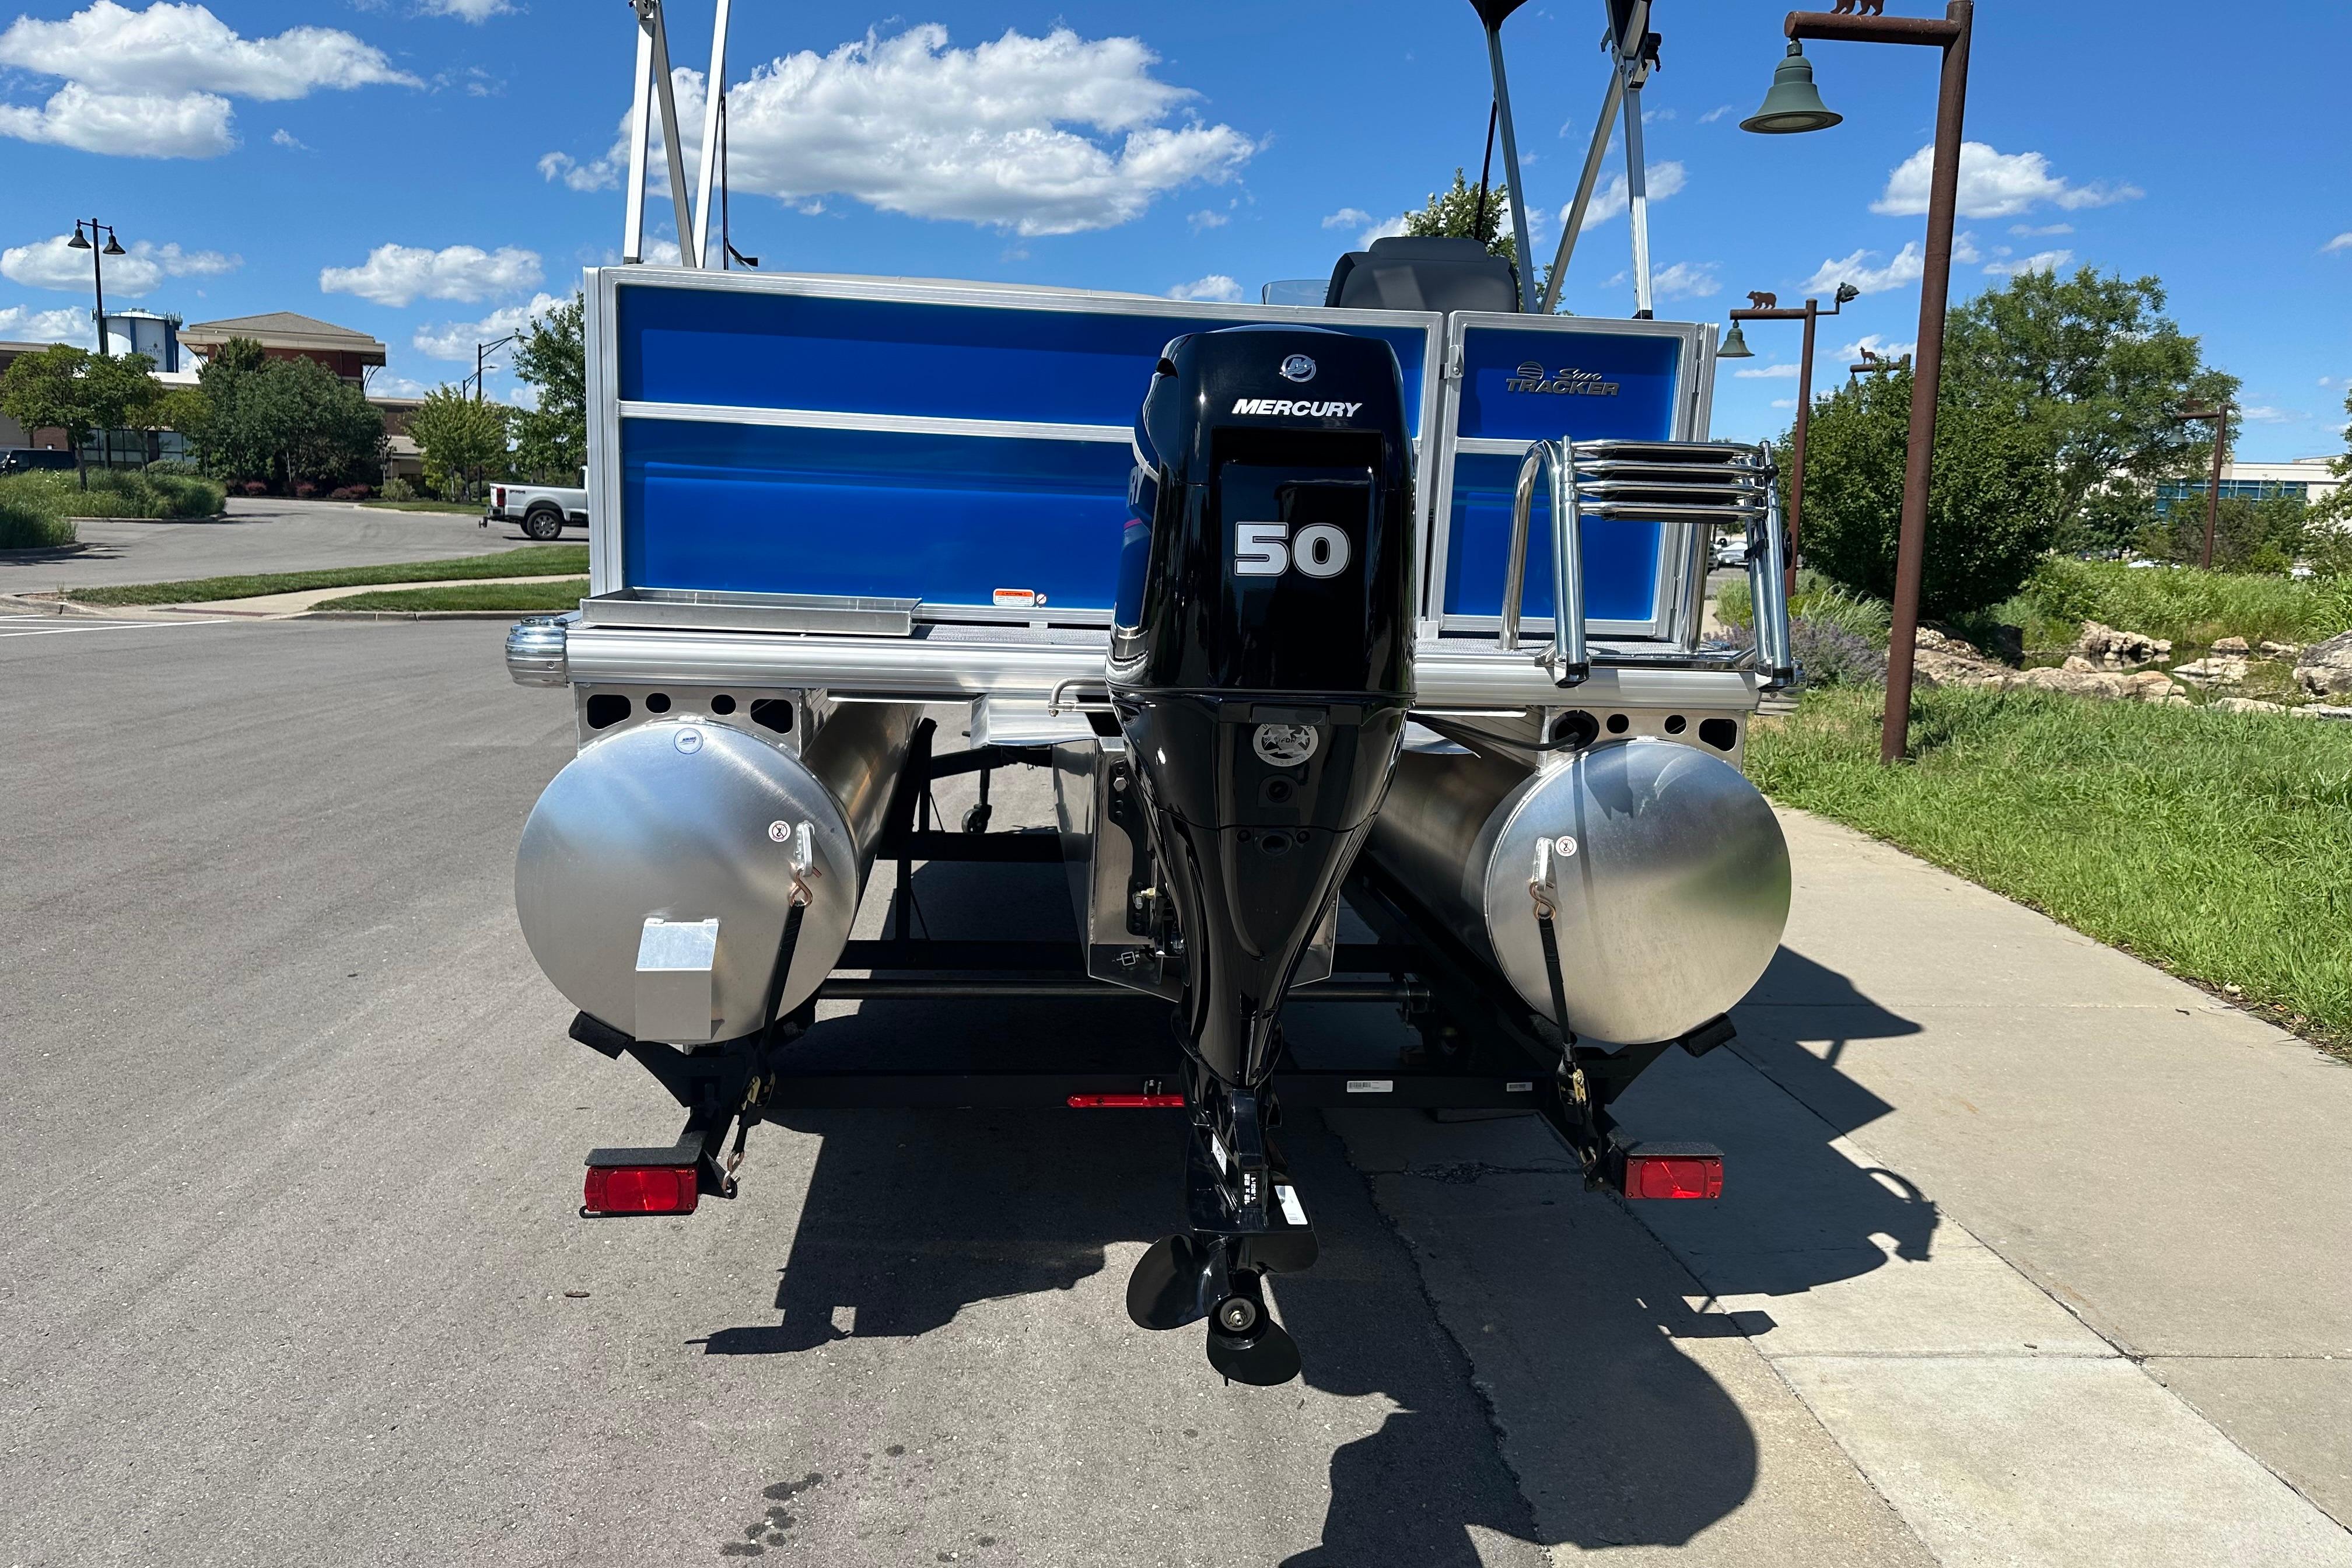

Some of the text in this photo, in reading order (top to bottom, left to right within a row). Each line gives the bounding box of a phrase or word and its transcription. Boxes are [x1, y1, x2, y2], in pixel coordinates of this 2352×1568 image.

[1553, 368, 1602, 382] Sun
[1506, 378, 1620, 396] TRACKER
[1231, 398, 1363, 417] MERCURY
[1234, 521, 1351, 579] 50
[1244, 1173, 1250, 1186] 22
[1244, 1194, 1250, 1205] 12
